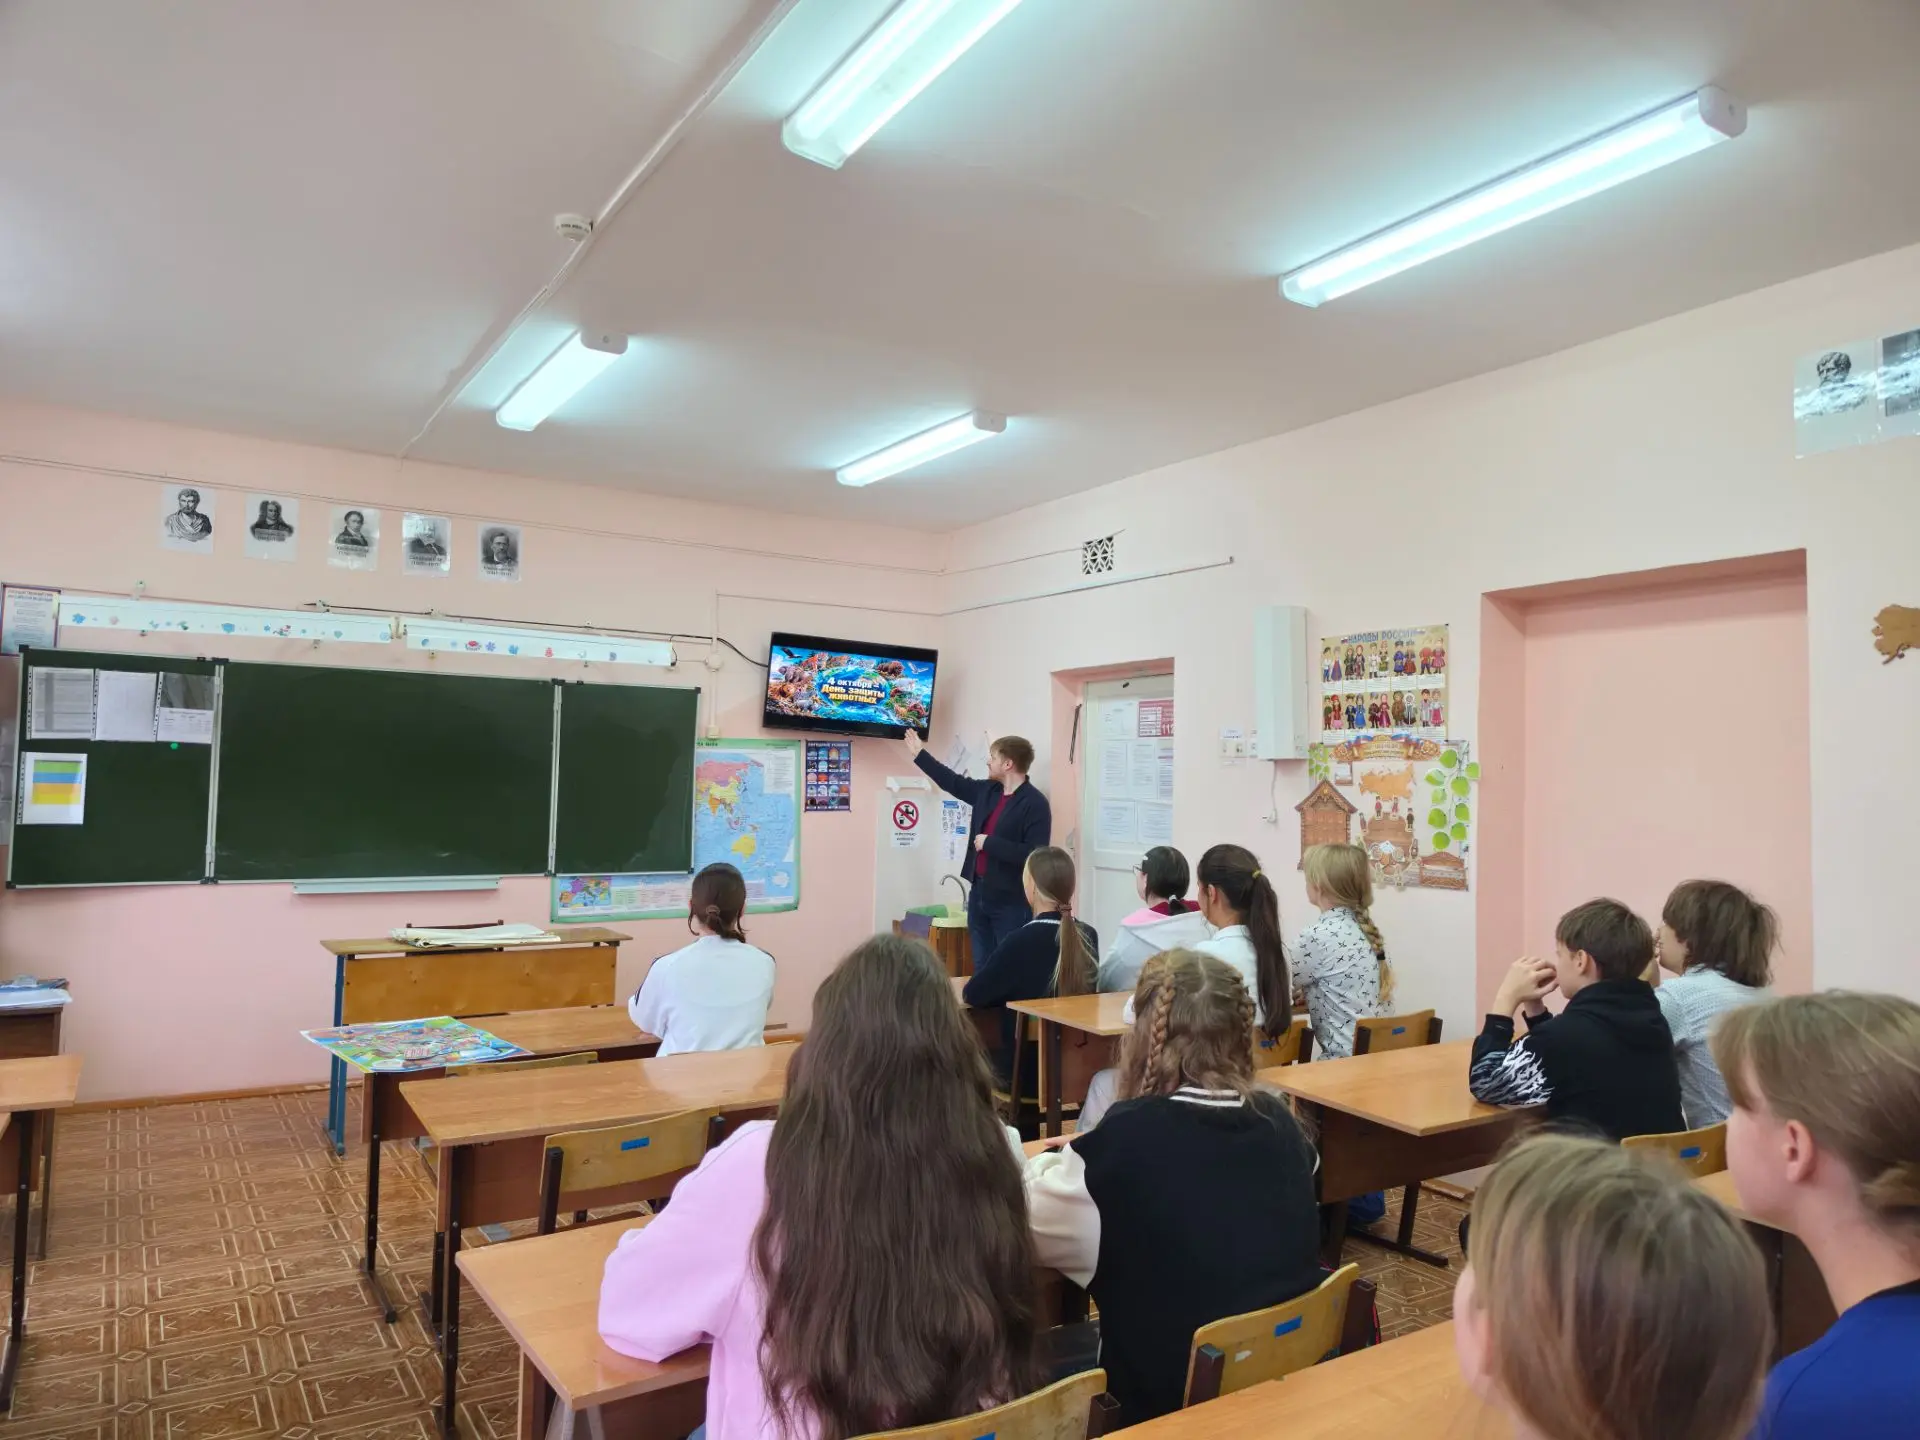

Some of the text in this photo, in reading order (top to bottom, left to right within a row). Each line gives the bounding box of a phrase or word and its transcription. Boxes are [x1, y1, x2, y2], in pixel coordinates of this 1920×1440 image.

[827, 677, 836, 685] 4
[837, 680, 872, 689] октября
[821, 684, 885, 698] День защиты
[829, 693, 877, 704] животных
